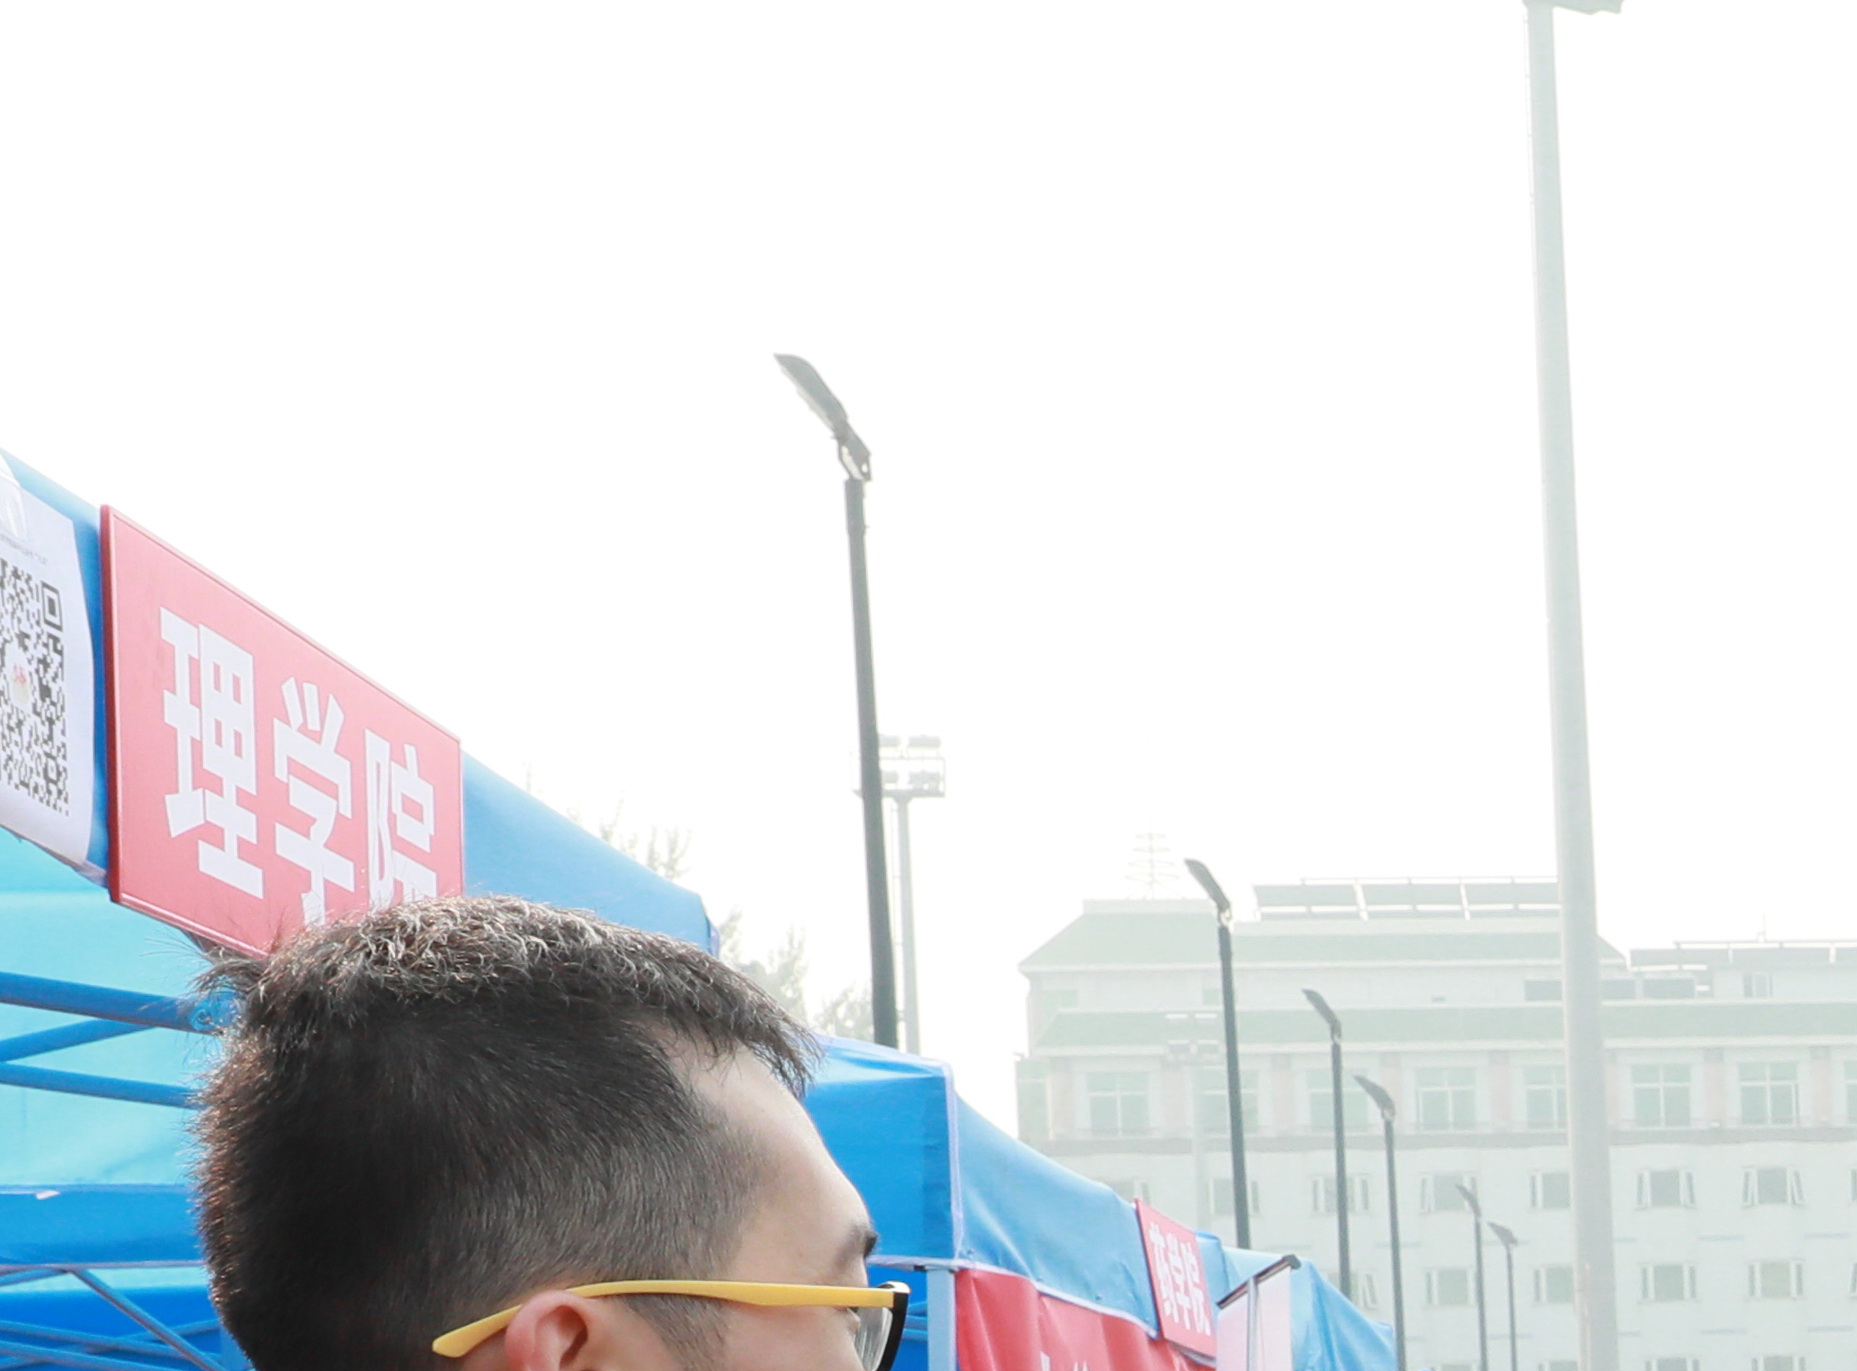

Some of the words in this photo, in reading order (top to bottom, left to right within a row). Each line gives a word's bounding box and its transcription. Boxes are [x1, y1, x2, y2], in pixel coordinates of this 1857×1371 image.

[160, 606, 437, 926] 理学院
[1149, 1221, 1212, 1337] 药学院
